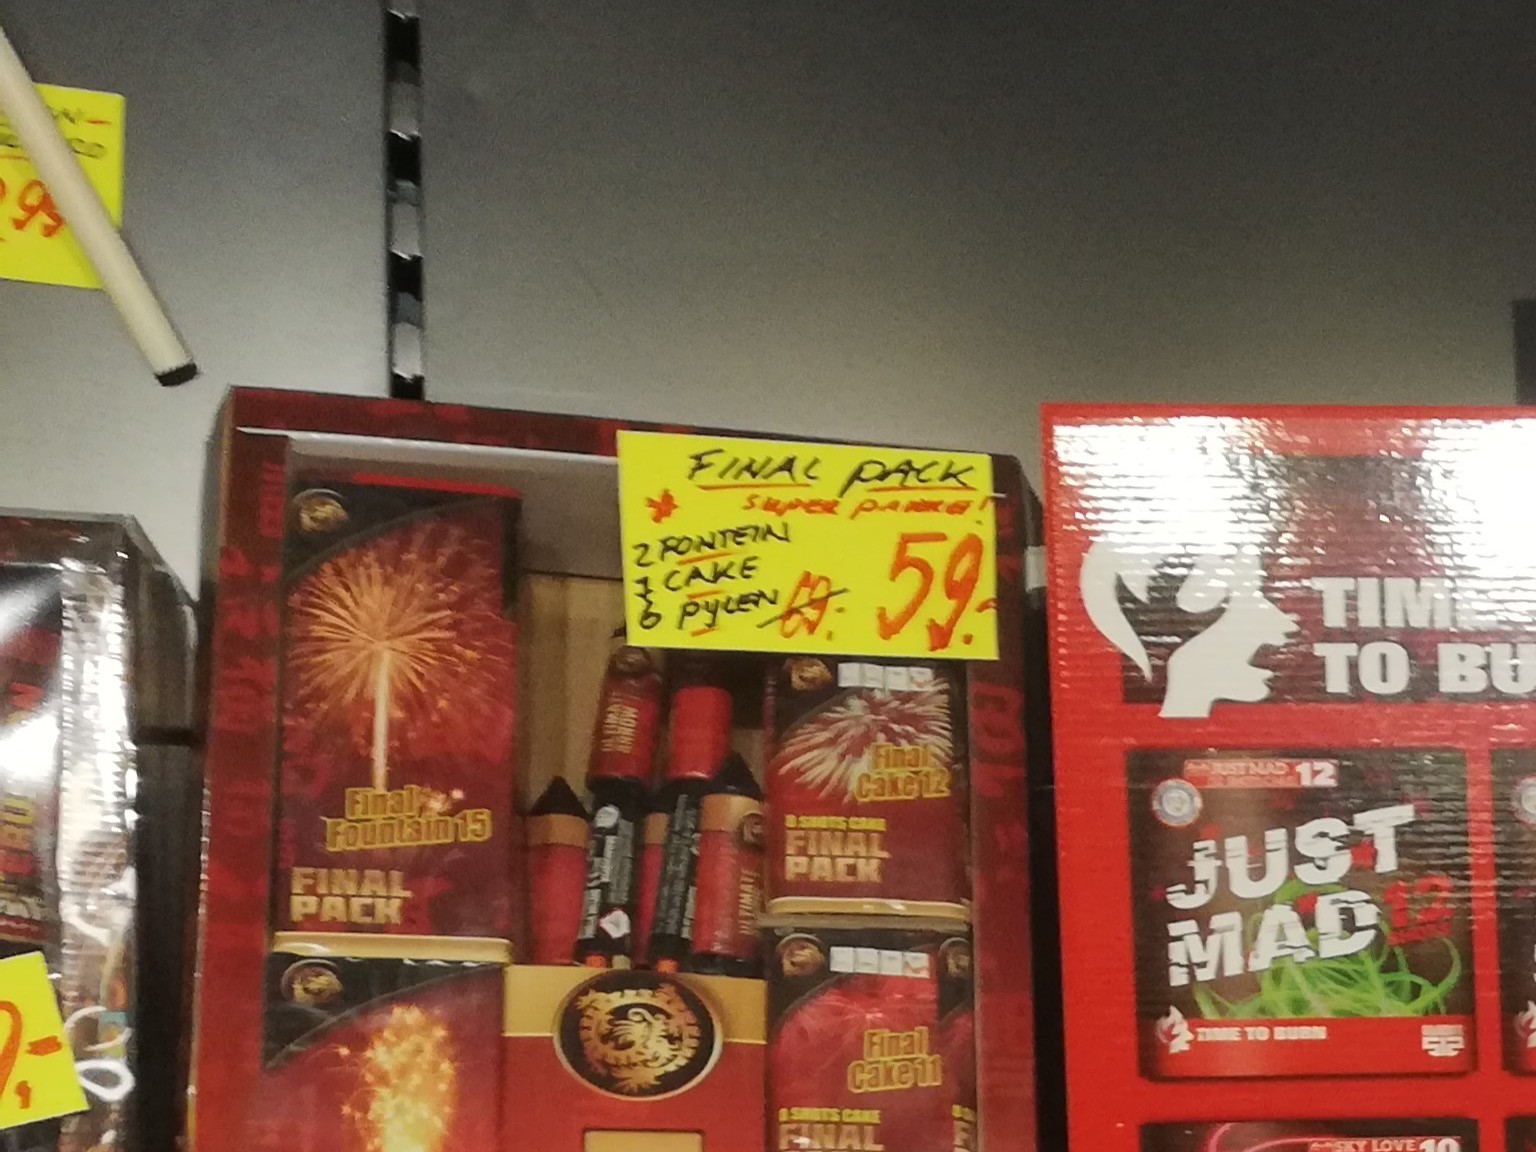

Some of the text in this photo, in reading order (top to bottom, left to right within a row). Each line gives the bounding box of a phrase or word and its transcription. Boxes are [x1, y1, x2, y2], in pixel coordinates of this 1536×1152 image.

[689, 449, 821, 481] FINAL
[634, 544, 654, 568] 2
[664, 556, 759, 592] CAKE
[1312, 641, 1413, 694] TO
[326, 808, 492, 852] Fountain 15
[1164, 804, 1416, 911] JUST
[291, 868, 413, 900] FINAL
[290, 895, 404, 924] PACK
[1166, 889, 1382, 989] MAD
[863, 1027, 928, 1059] Final
[847, 1058, 913, 1093] Cake
